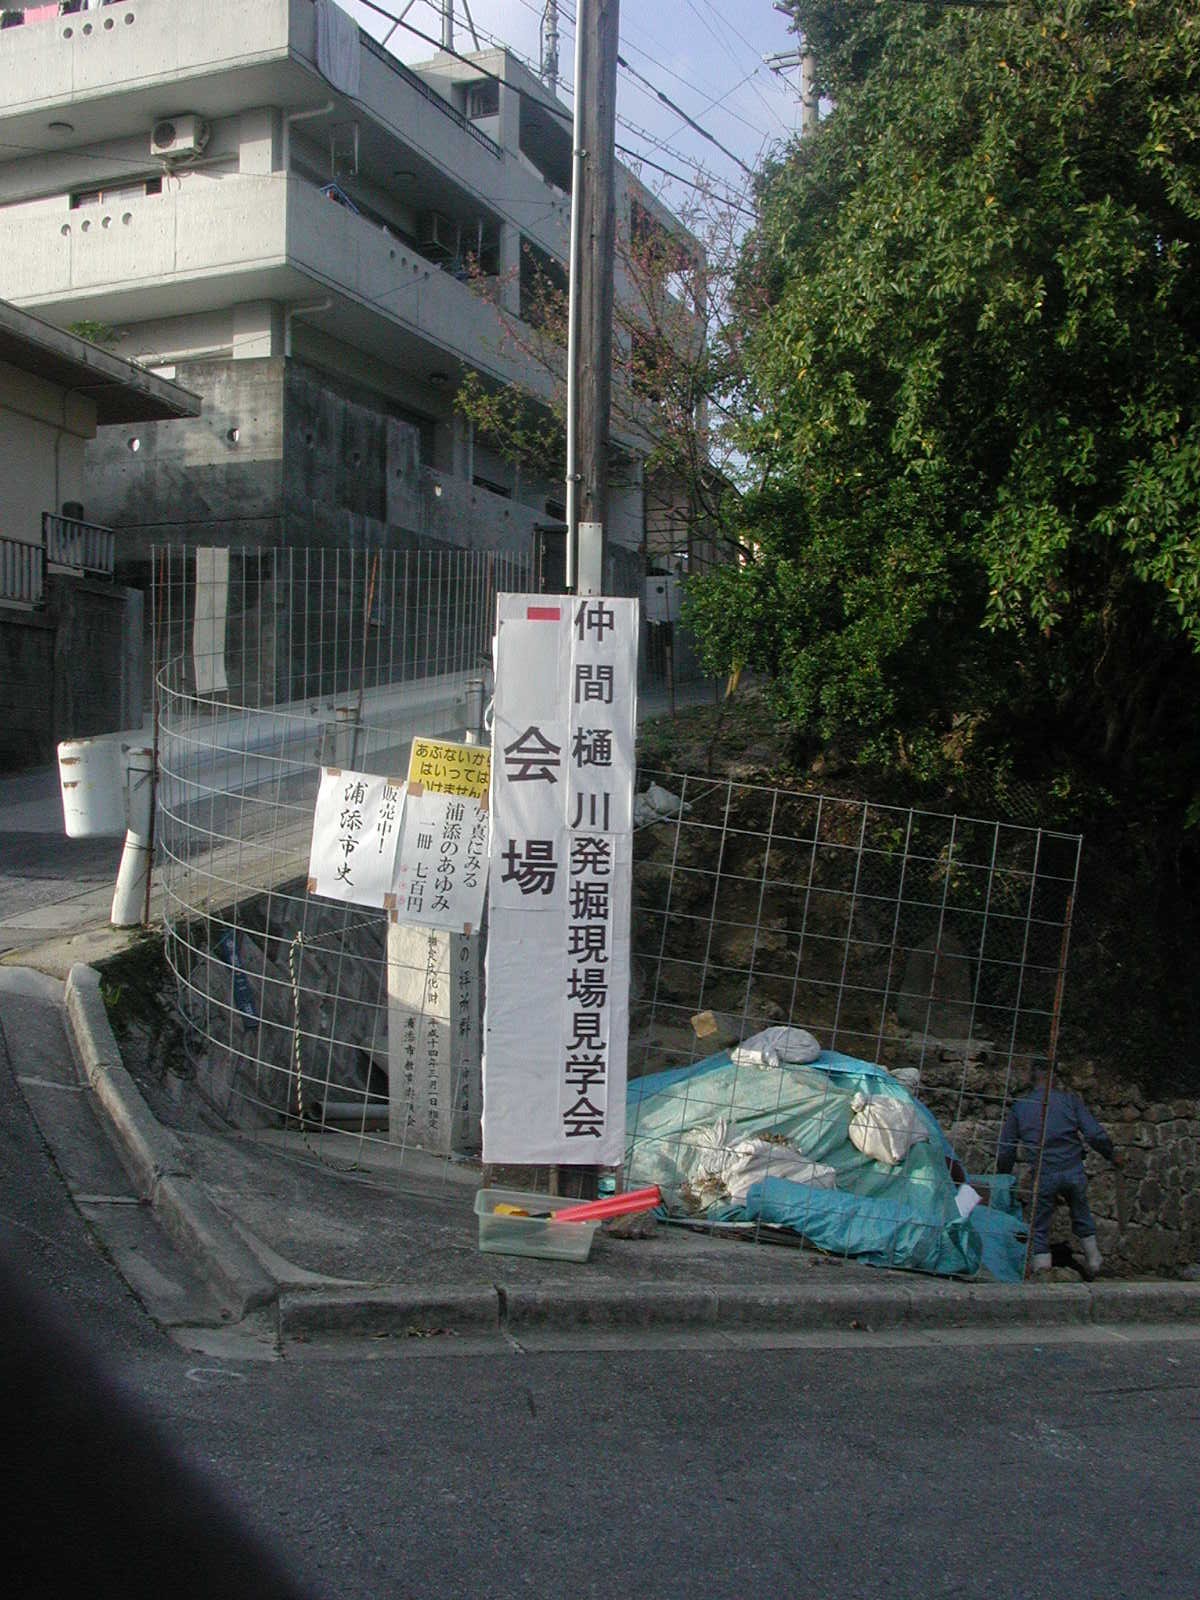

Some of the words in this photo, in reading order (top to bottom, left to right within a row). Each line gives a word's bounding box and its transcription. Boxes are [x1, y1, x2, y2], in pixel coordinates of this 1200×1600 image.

[420, 762, 490, 784] はいっては
[502, 725, 562, 896] 会場
[334, 781, 368, 887] 浦添市史
[431, 802, 465, 911] 浦添のあゆみ
[463, 805, 488, 888] 写真にみる
[562, 601, 615, 1138] 仲間樋川発掘現場見学会
